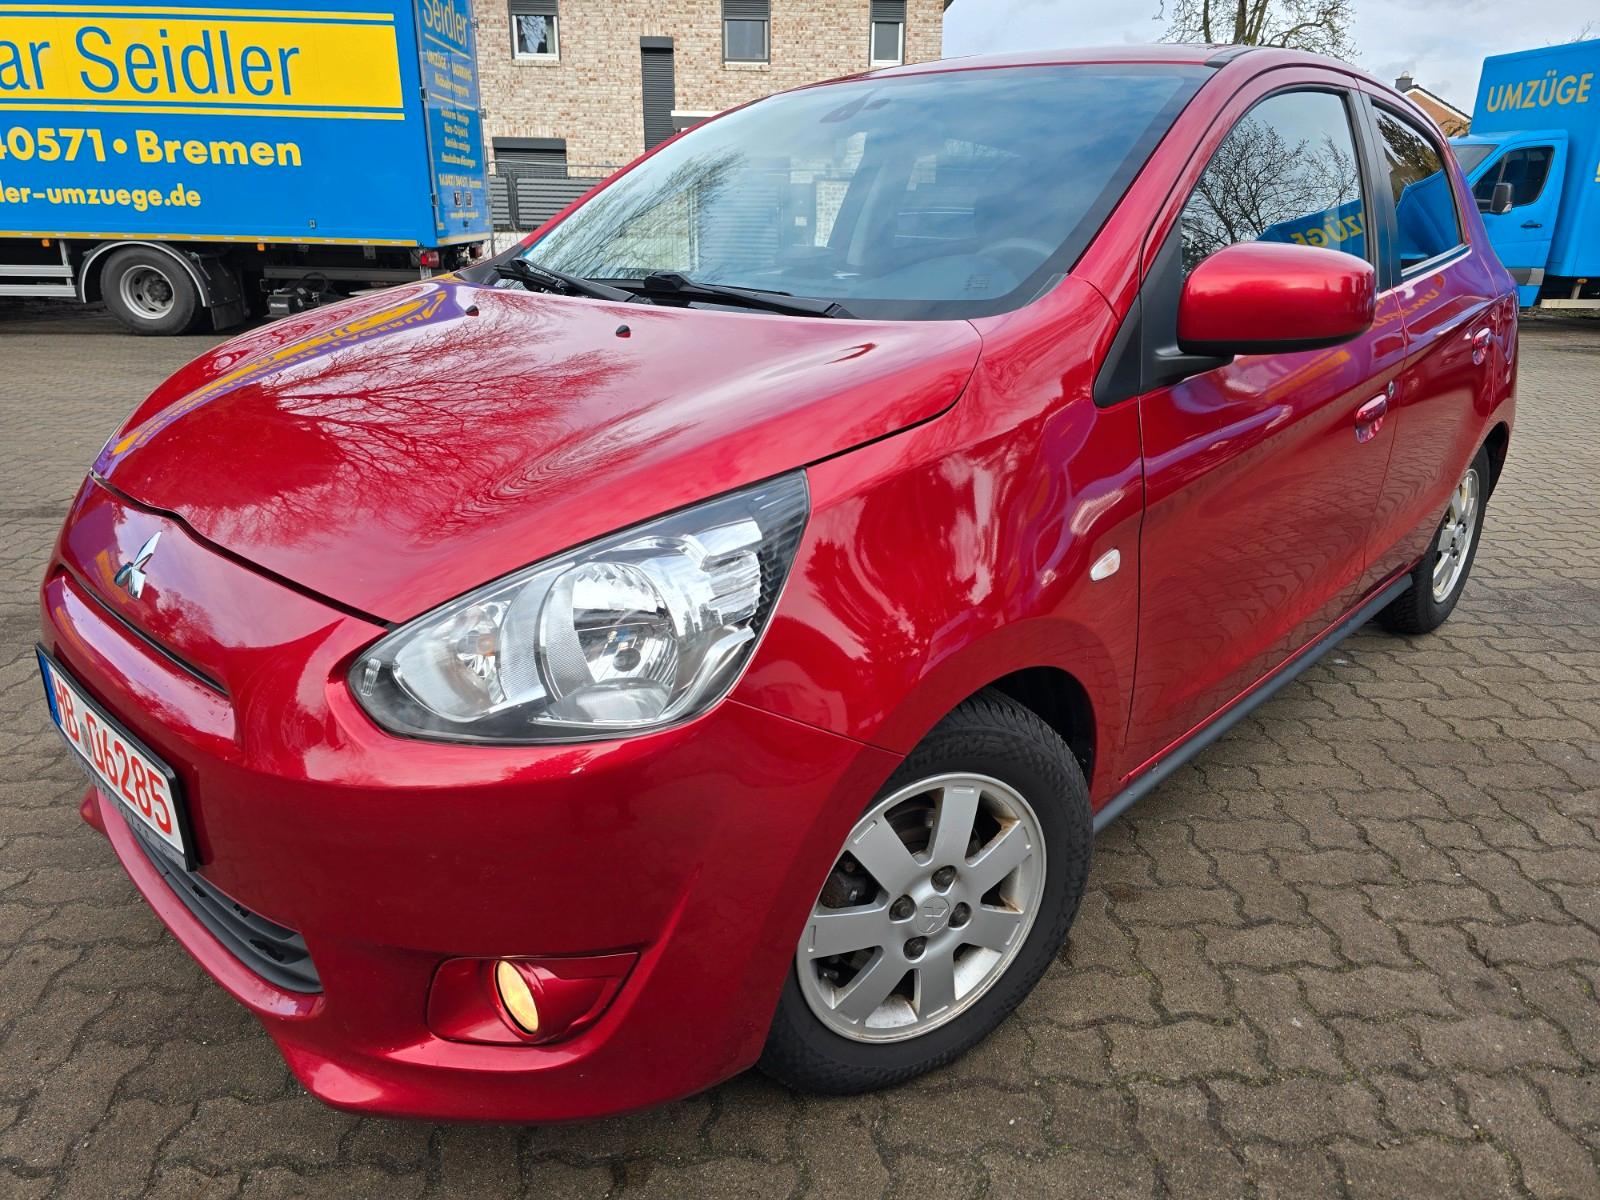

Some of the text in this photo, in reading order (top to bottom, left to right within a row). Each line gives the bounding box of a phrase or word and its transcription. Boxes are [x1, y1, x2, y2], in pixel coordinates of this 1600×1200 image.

[0, 26, 299, 96] ar Seidler
[1487, 69, 1594, 112] UMZÜGE
[135, 129, 302, 166] Bremen
[52, 671, 80, 743] HB
[85, 711, 172, 835] 06285
